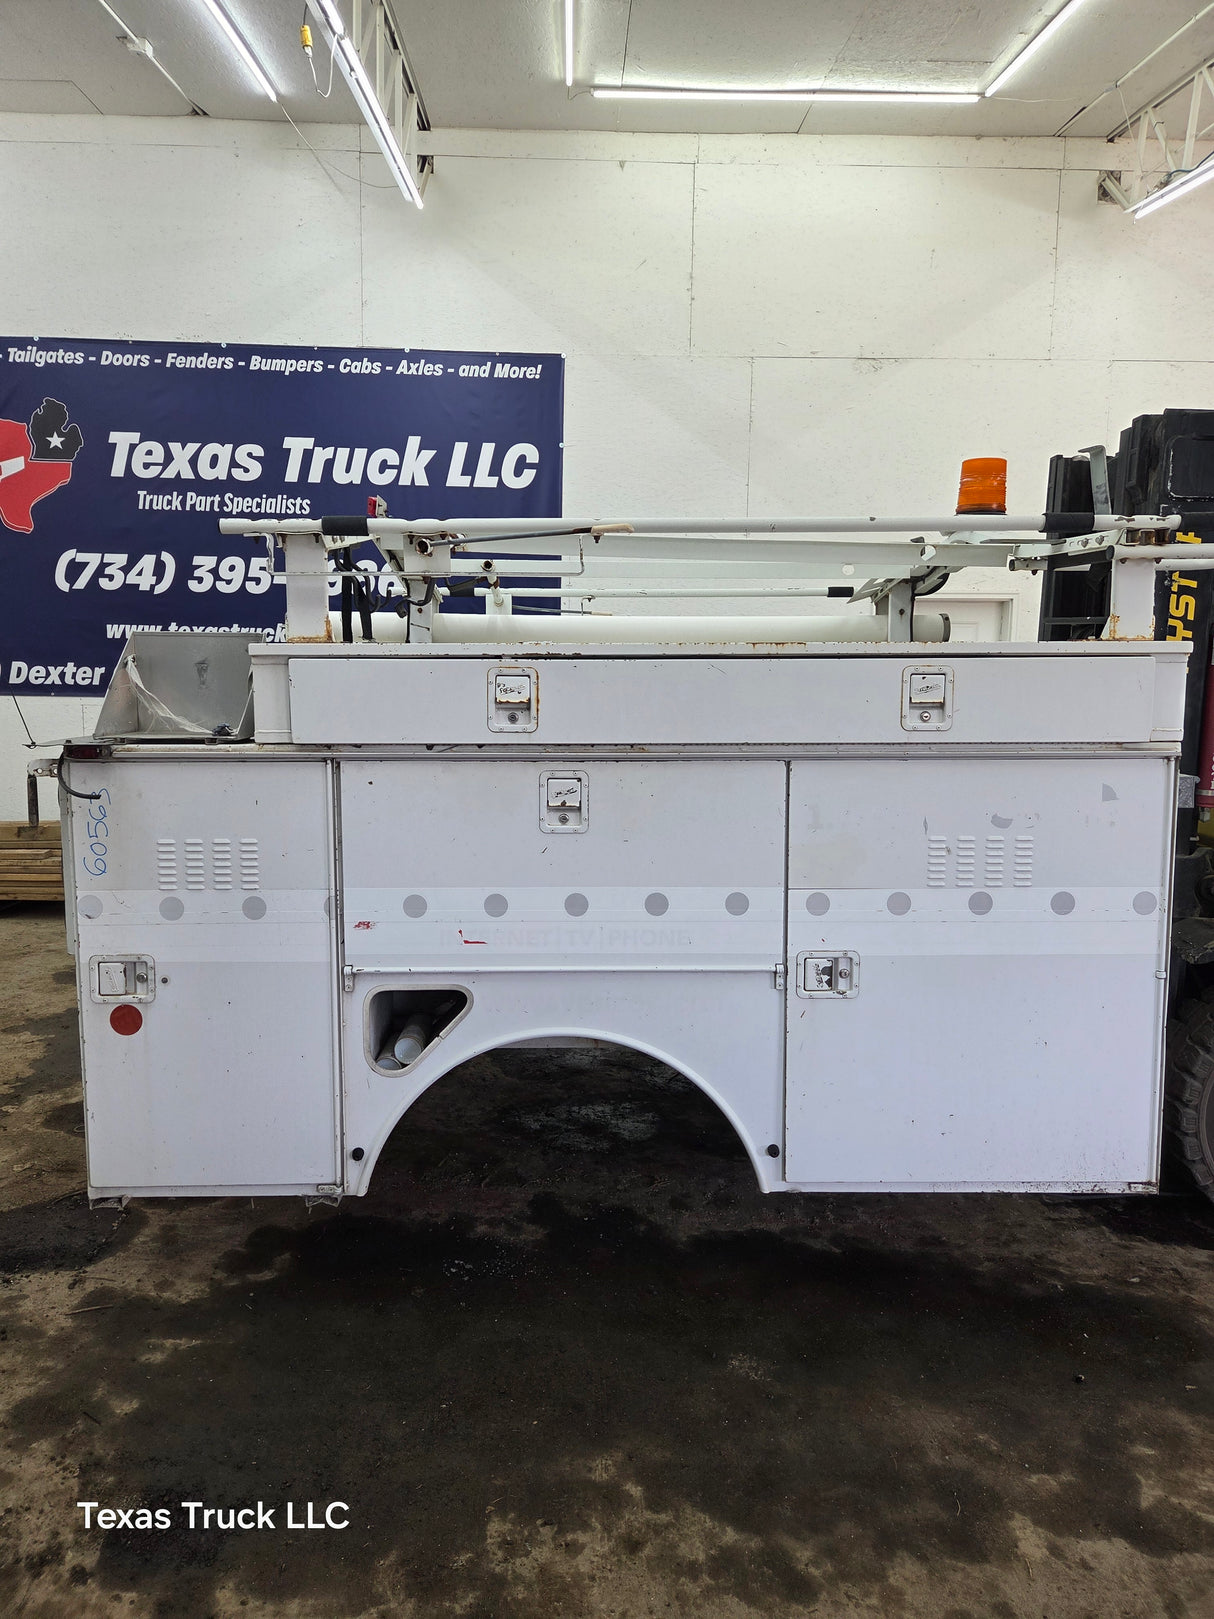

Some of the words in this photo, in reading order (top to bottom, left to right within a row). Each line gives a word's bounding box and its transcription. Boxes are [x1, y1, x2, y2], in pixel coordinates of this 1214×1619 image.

[7, 346, 85, 368] Tailgates
[100, 351, 151, 367] Doors
[165, 353, 235, 369] Fenders
[249, 355, 324, 376] Bumpers
[339, 357, 382, 374] Cabs
[396, 359, 444, 377] Axles
[458, 361, 491, 378] and
[494, 363, 543, 380] More!
[107, 431, 265, 482] Texas
[282, 435, 438, 487] Truck
[445, 441, 540, 490] LLC
[137, 490, 184, 511] Truck
[185, 491, 221, 512] Part
[223, 492, 311, 515] Specialists
[54, 548, 176, 595] (734)
[8, 660, 106, 686] Dexter
